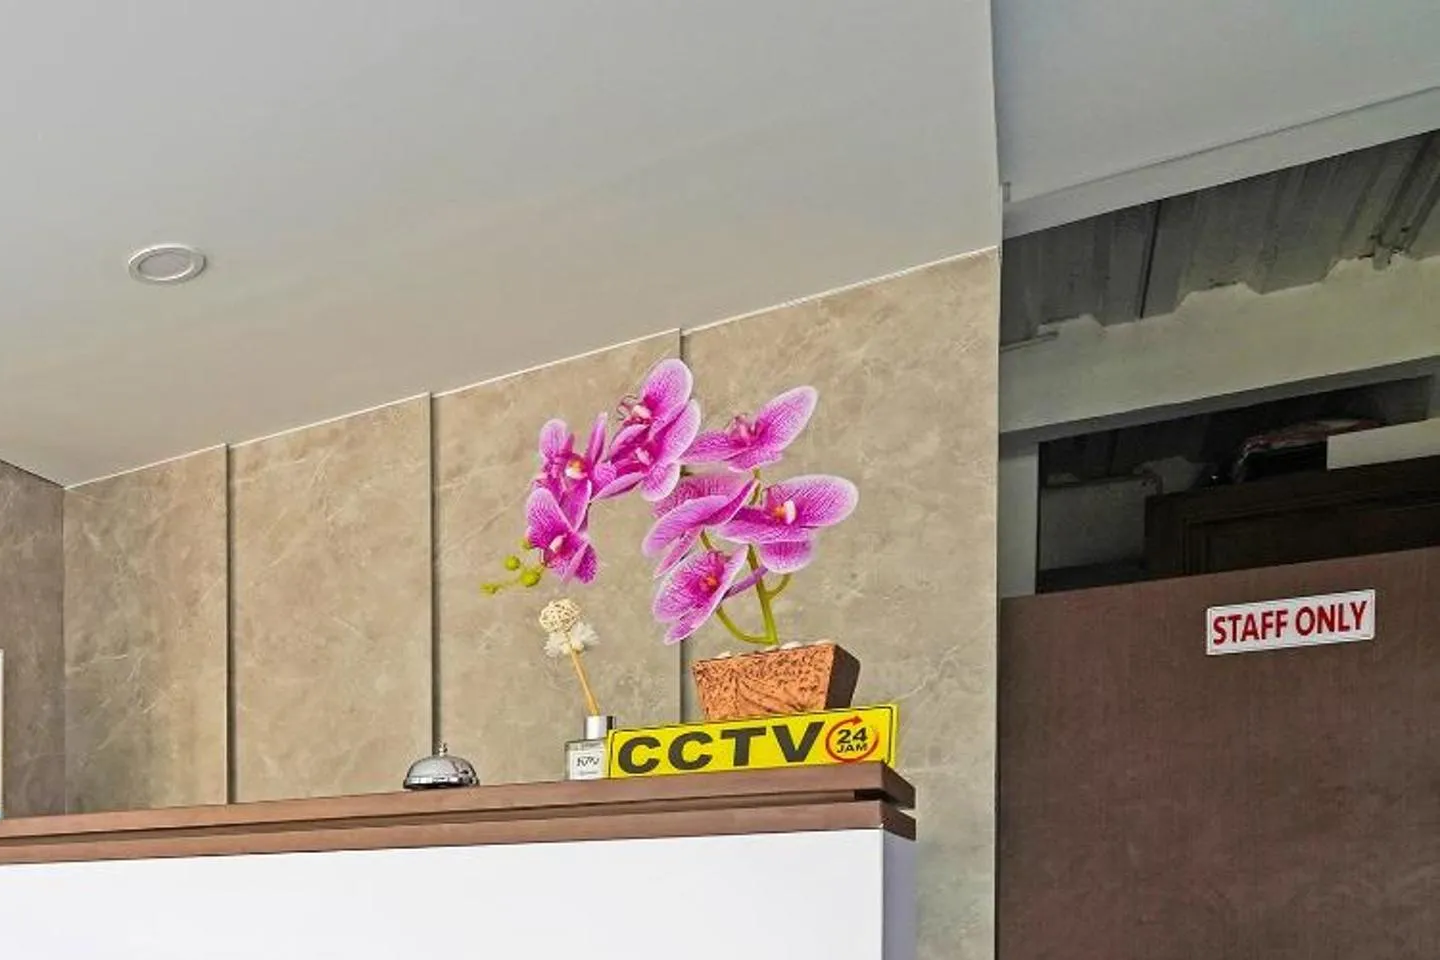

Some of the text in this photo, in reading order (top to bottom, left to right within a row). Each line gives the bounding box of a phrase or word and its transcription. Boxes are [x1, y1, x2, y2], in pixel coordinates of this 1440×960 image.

[1213, 600, 1367, 646] STAFF ONLY
[618, 721, 825, 774] CCTV
[836, 727, 868, 744] 24
[836, 742, 869, 754] JAM
